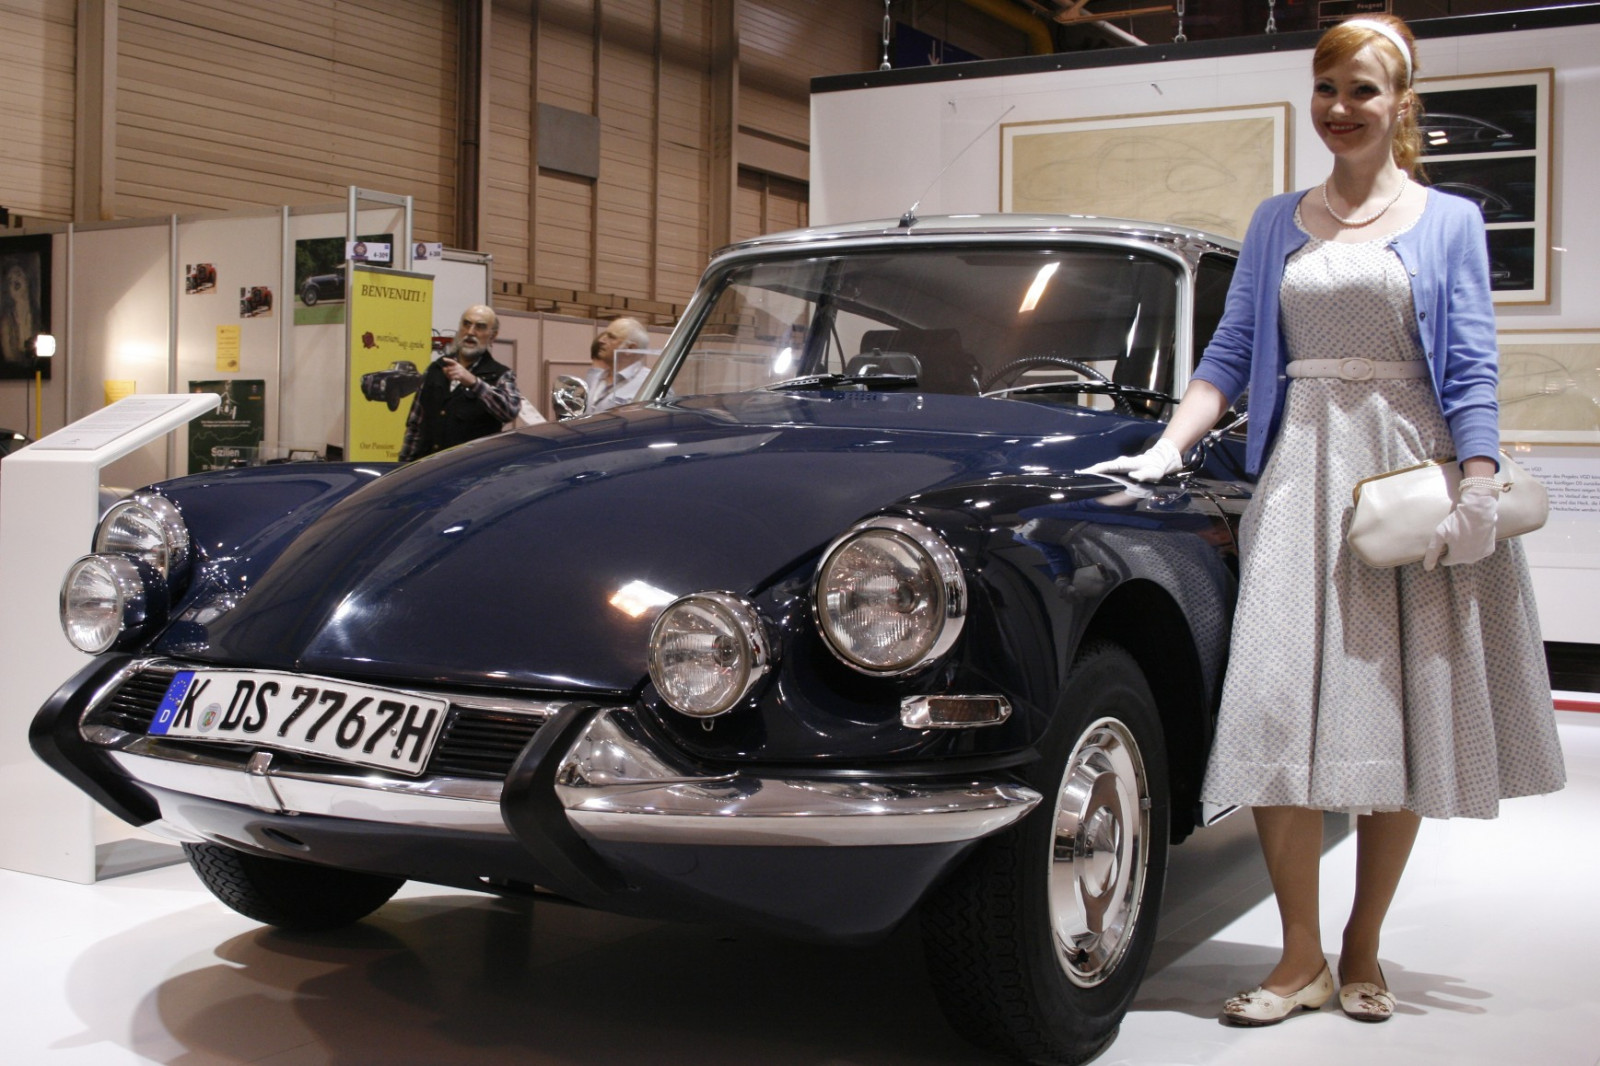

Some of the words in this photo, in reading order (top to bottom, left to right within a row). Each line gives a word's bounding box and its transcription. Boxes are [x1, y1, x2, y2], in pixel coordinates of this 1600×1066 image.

[361, 284, 420, 302] BENVENUTI
[422, 292, 426, 302] !
[159, 709, 169, 723] D
[173, 678, 211, 728] K
[218, 680, 280, 733] DS
[277, 686, 438, 763] 7767H
